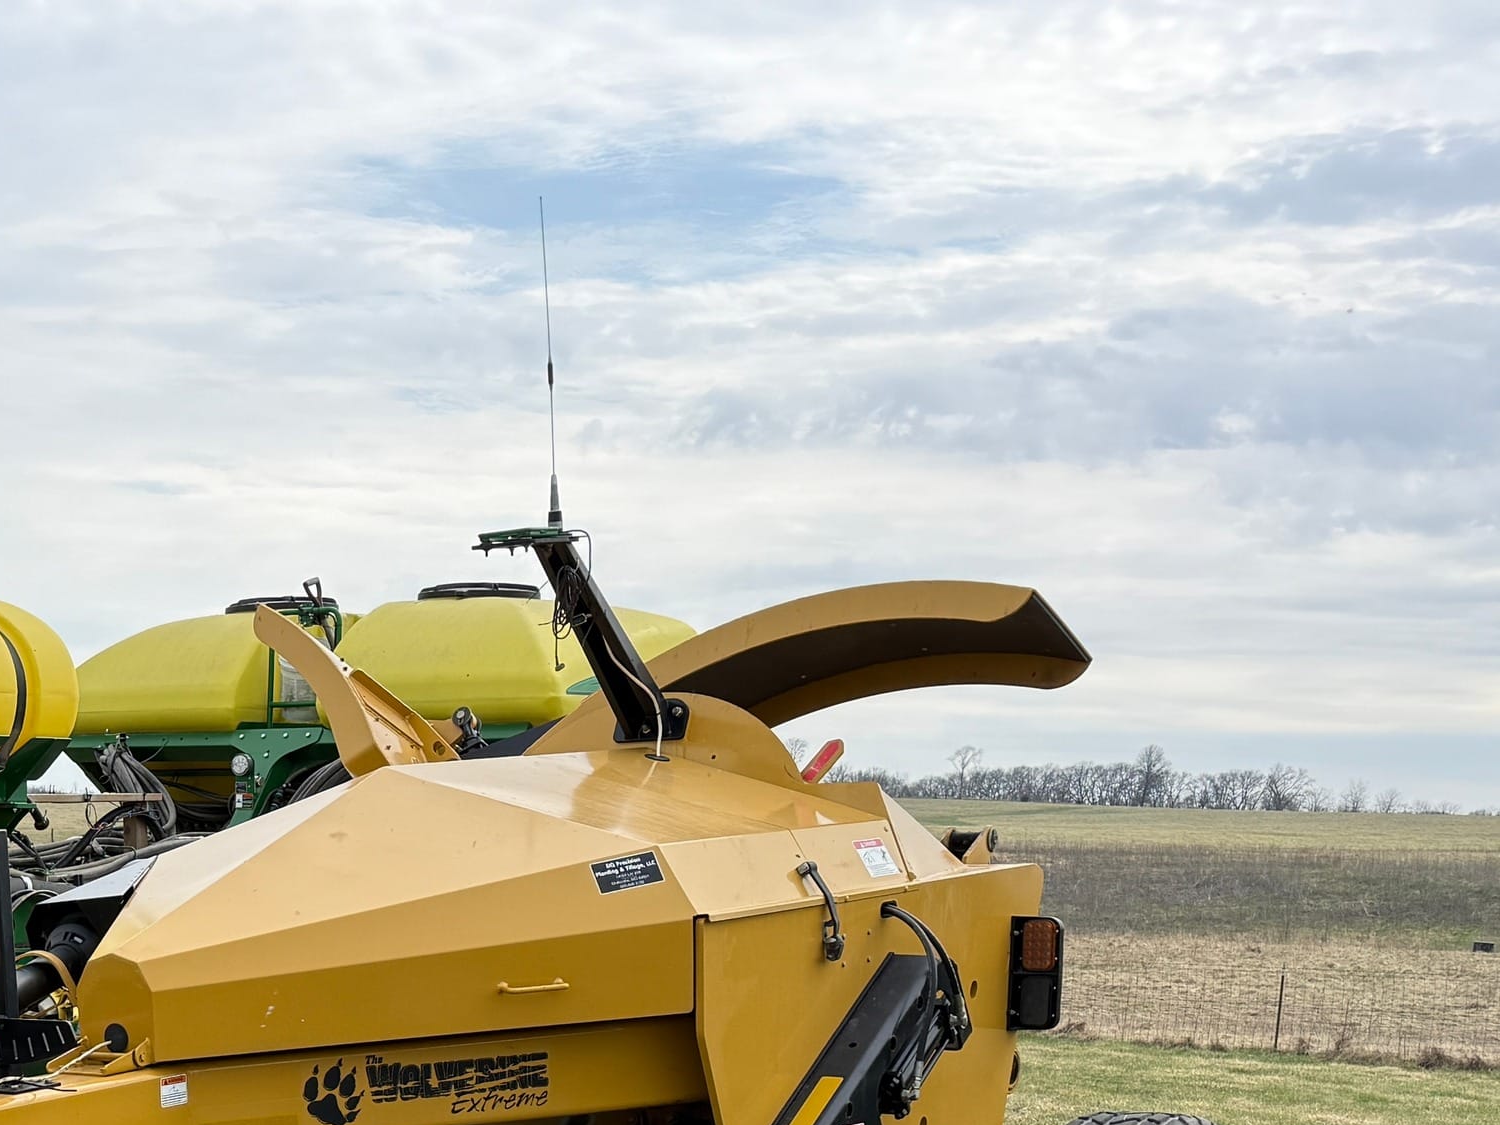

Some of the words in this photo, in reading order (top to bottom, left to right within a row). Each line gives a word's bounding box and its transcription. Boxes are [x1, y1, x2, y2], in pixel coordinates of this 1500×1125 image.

[365, 1055, 383, 1065] The
[365, 1052, 549, 1104] WOLVERINE
[451, 1090, 549, 1115] Extreme
